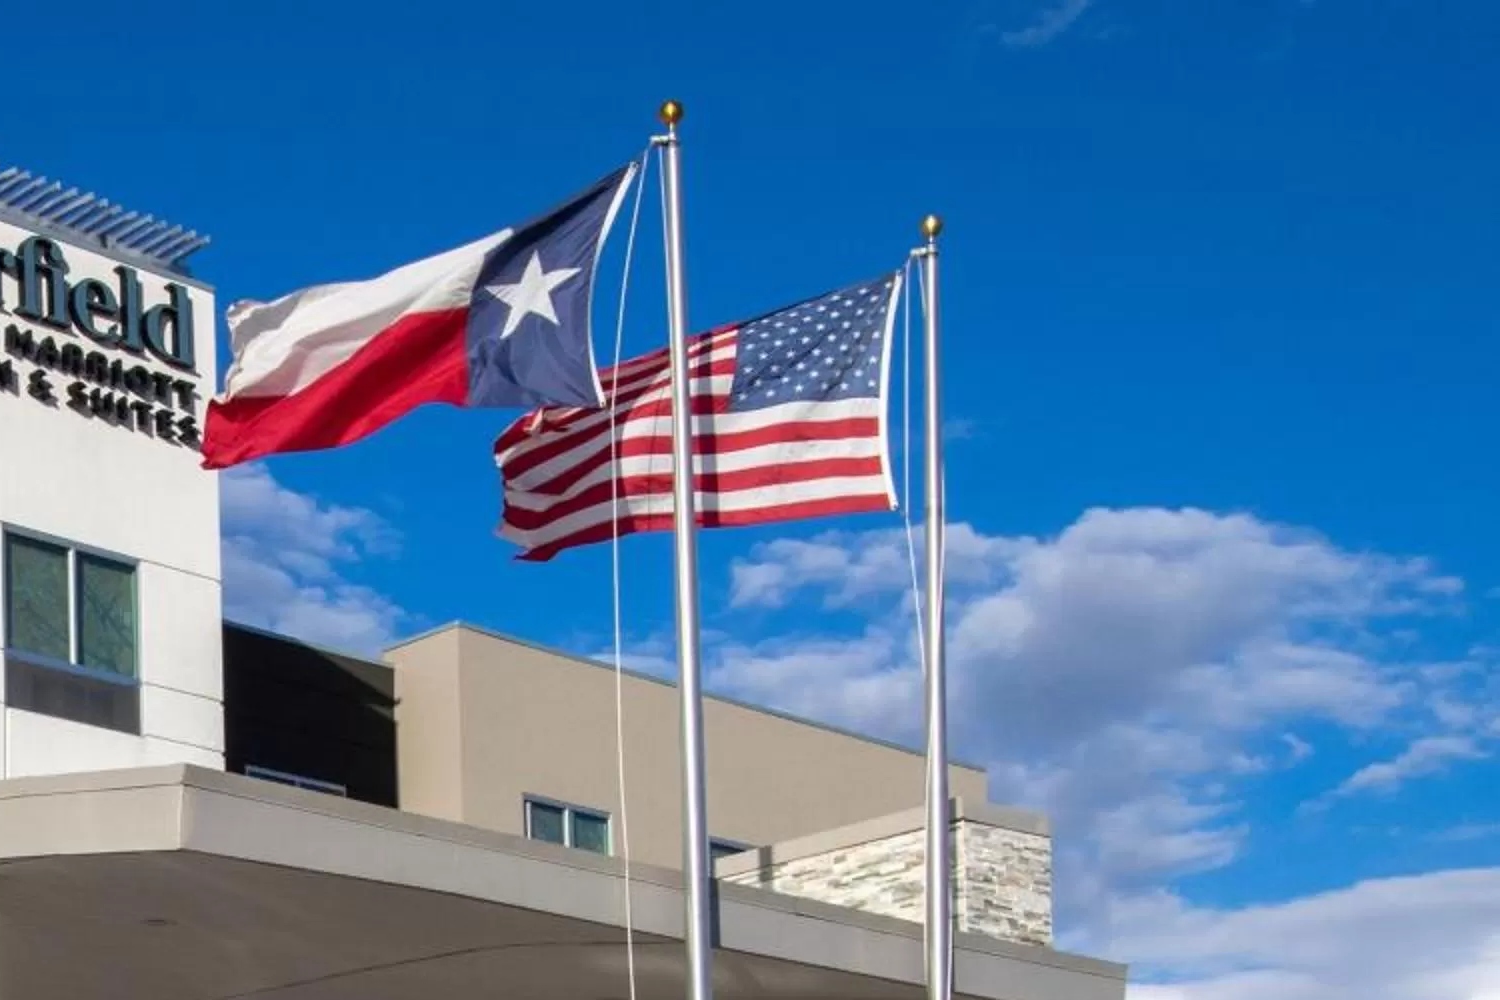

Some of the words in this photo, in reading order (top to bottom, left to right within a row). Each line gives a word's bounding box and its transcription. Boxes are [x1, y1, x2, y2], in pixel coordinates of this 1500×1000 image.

[4, 324, 197, 412] MARRIOTT
[28, 369, 55, 405] &
[66, 381, 201, 450] SUITES
